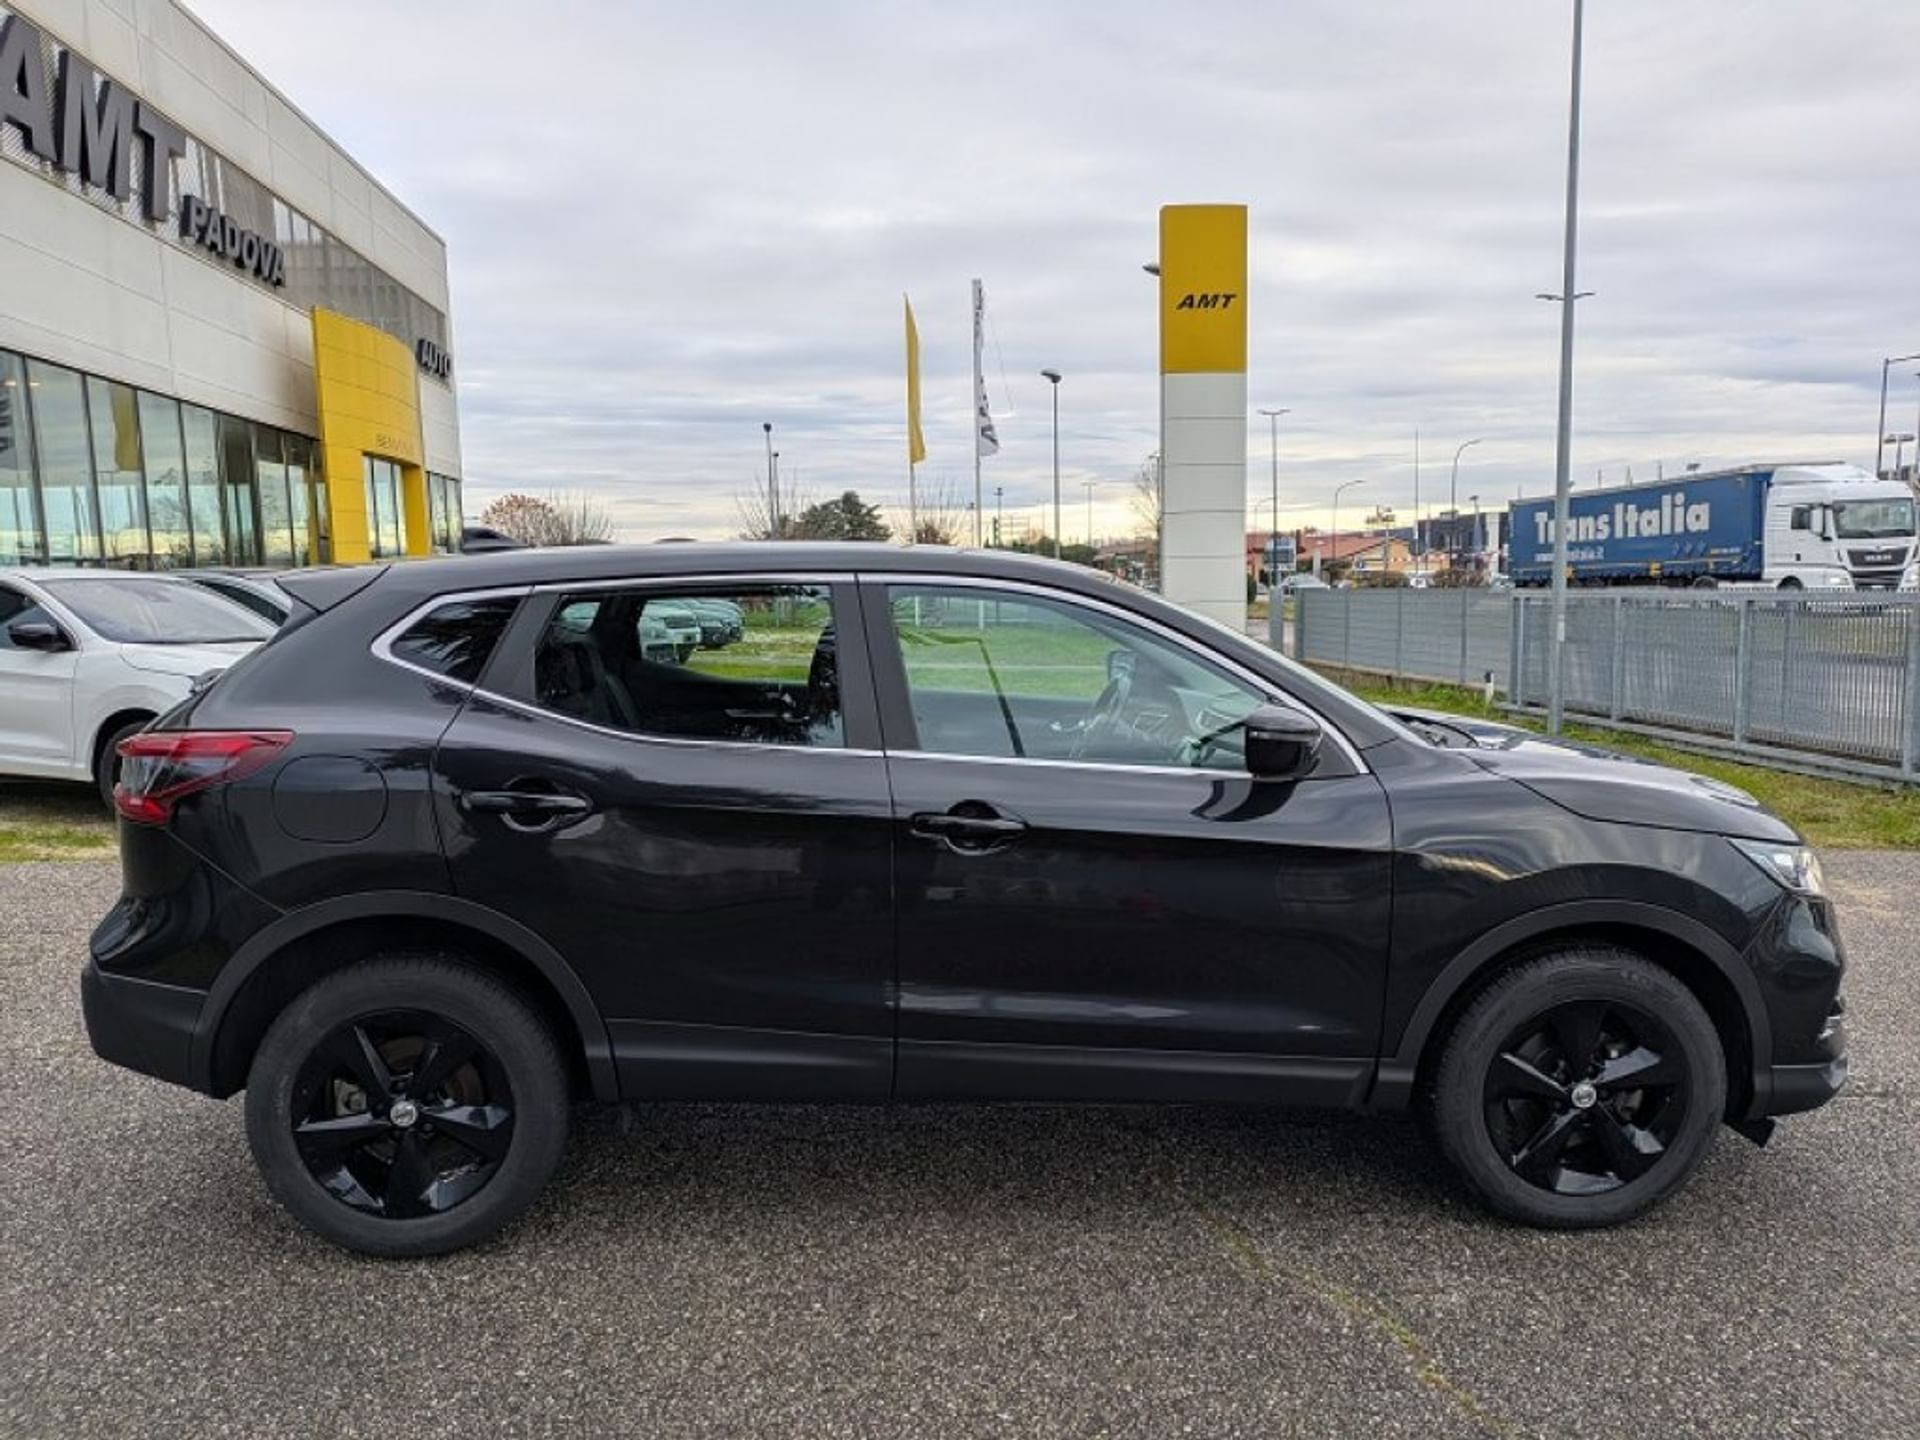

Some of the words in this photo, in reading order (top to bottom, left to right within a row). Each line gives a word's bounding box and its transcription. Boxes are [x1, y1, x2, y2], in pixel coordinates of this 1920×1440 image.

[0, 14, 187, 222] AMT
[179, 194, 286, 286] PADOVA
[1176, 293, 1237, 310] AMT
